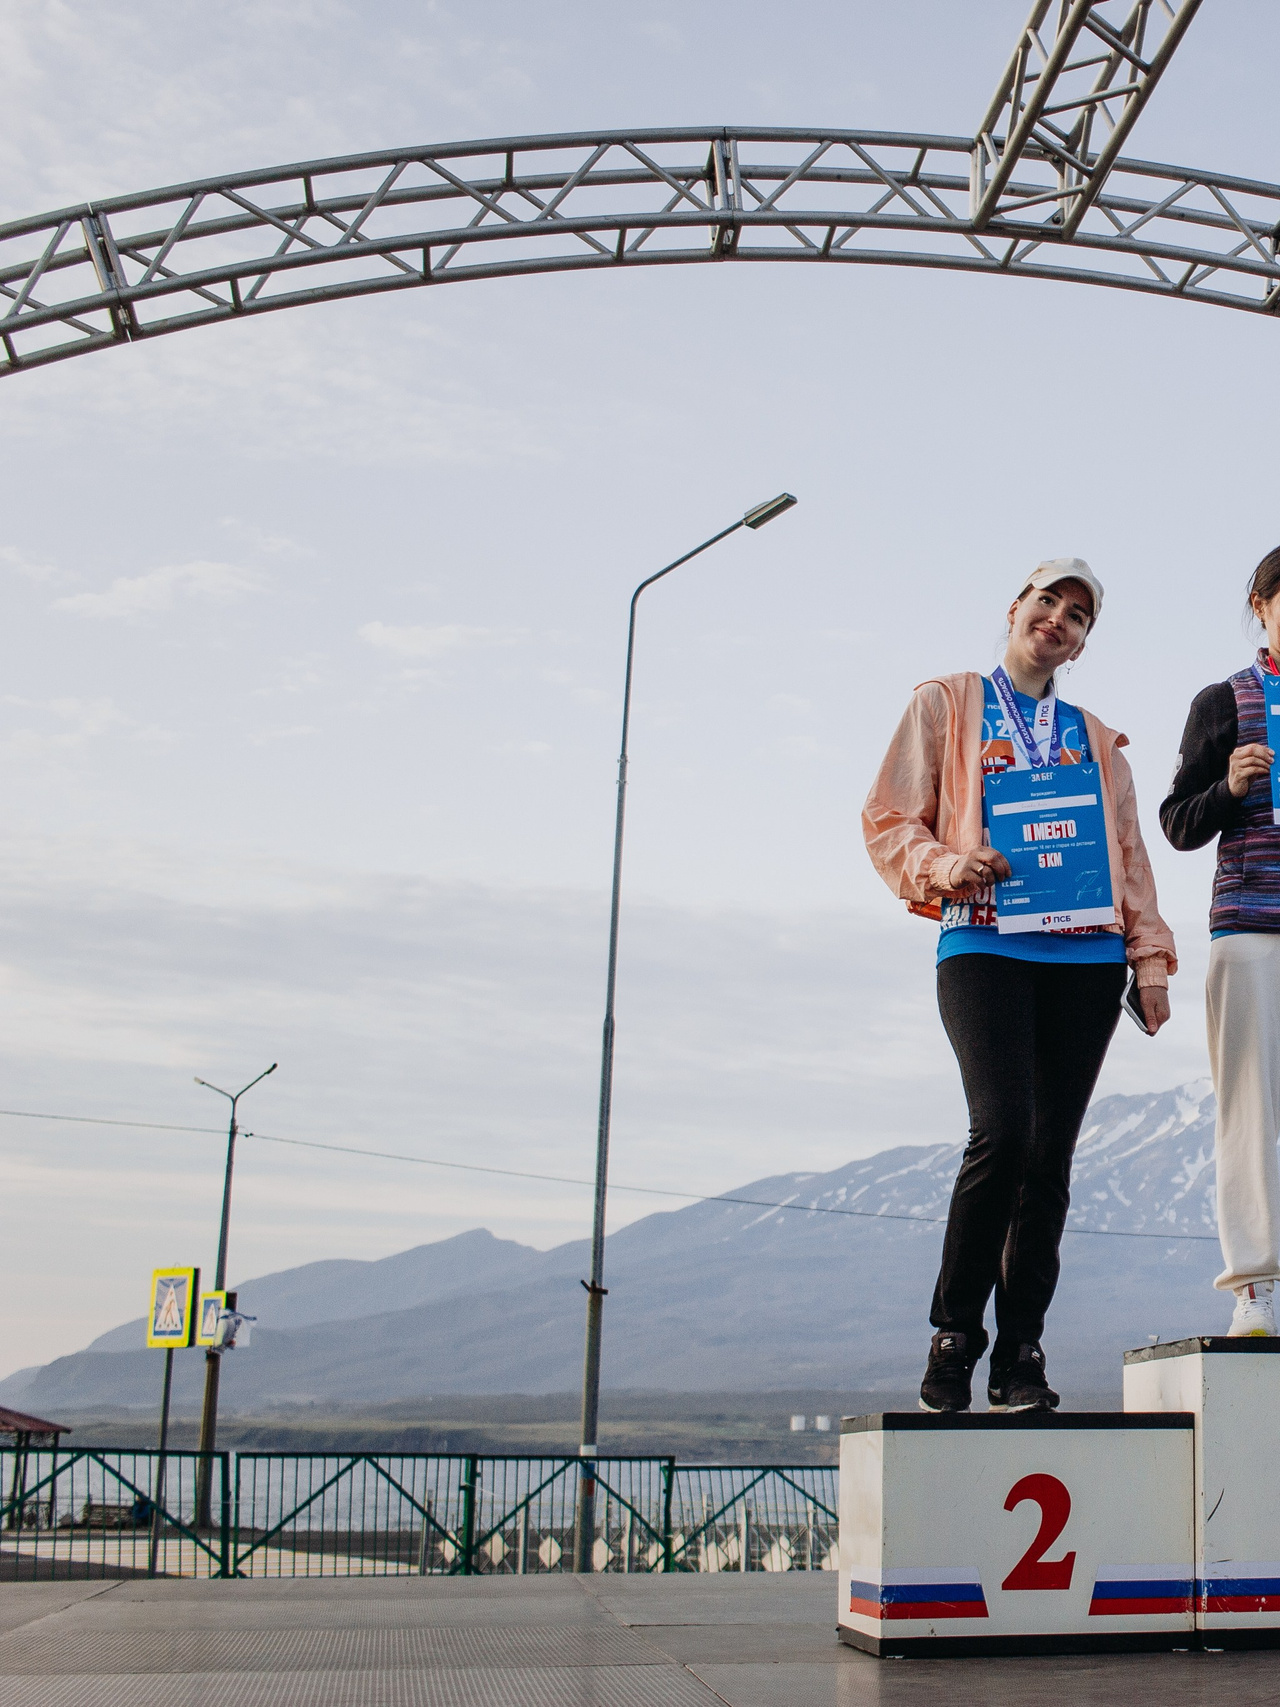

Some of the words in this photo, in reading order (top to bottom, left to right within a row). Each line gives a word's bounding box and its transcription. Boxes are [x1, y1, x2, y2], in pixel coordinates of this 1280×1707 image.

[1040, 704, 1050, 718] ПСБ
[1010, 701, 1032, 744] САХАЛИНСКАЯ
[1034, 819, 1078, 841] МЕСТО
[1038, 854, 1046, 868] 5
[1046, 852, 1062, 868] КМ
[1053, 915, 1072, 923] ПСБ
[1001, 1472, 1077, 1591] 2
